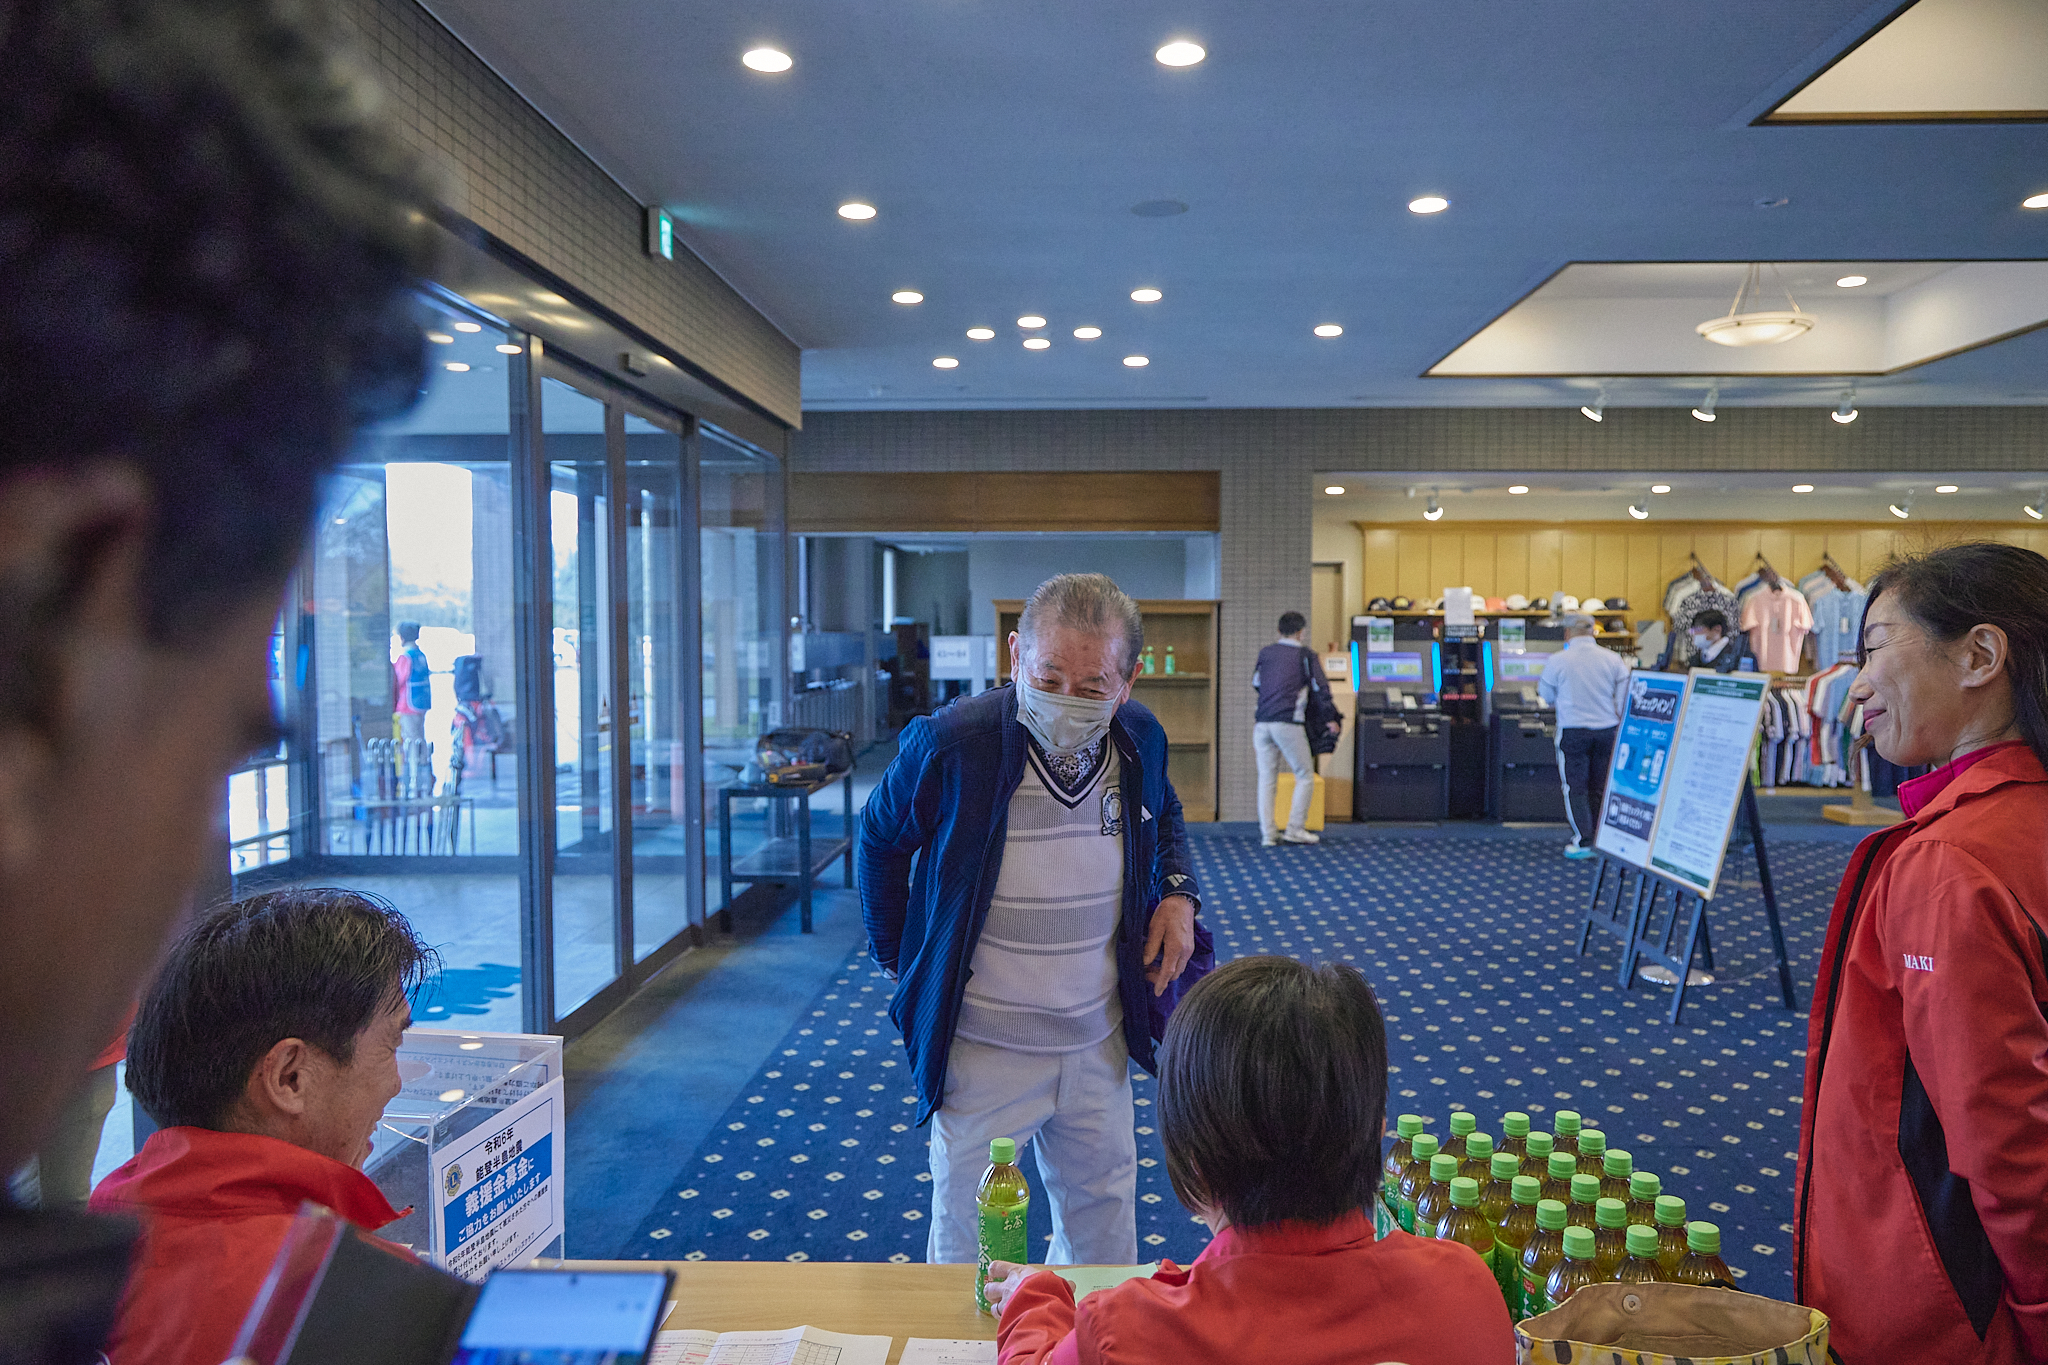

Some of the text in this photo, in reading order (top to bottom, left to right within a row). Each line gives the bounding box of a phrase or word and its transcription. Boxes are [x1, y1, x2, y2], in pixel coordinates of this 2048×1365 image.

[1903, 954, 1934, 972] MAKI
[484, 1127, 514, 1155] 令和6年
[475, 1139, 523, 1182] 能登半島地震
[464, 1156, 535, 1218] 義援金募金に
[458, 1172, 541, 1243] ご協力をお願いいたします
[1003, 1214, 1023, 1230] お茶
